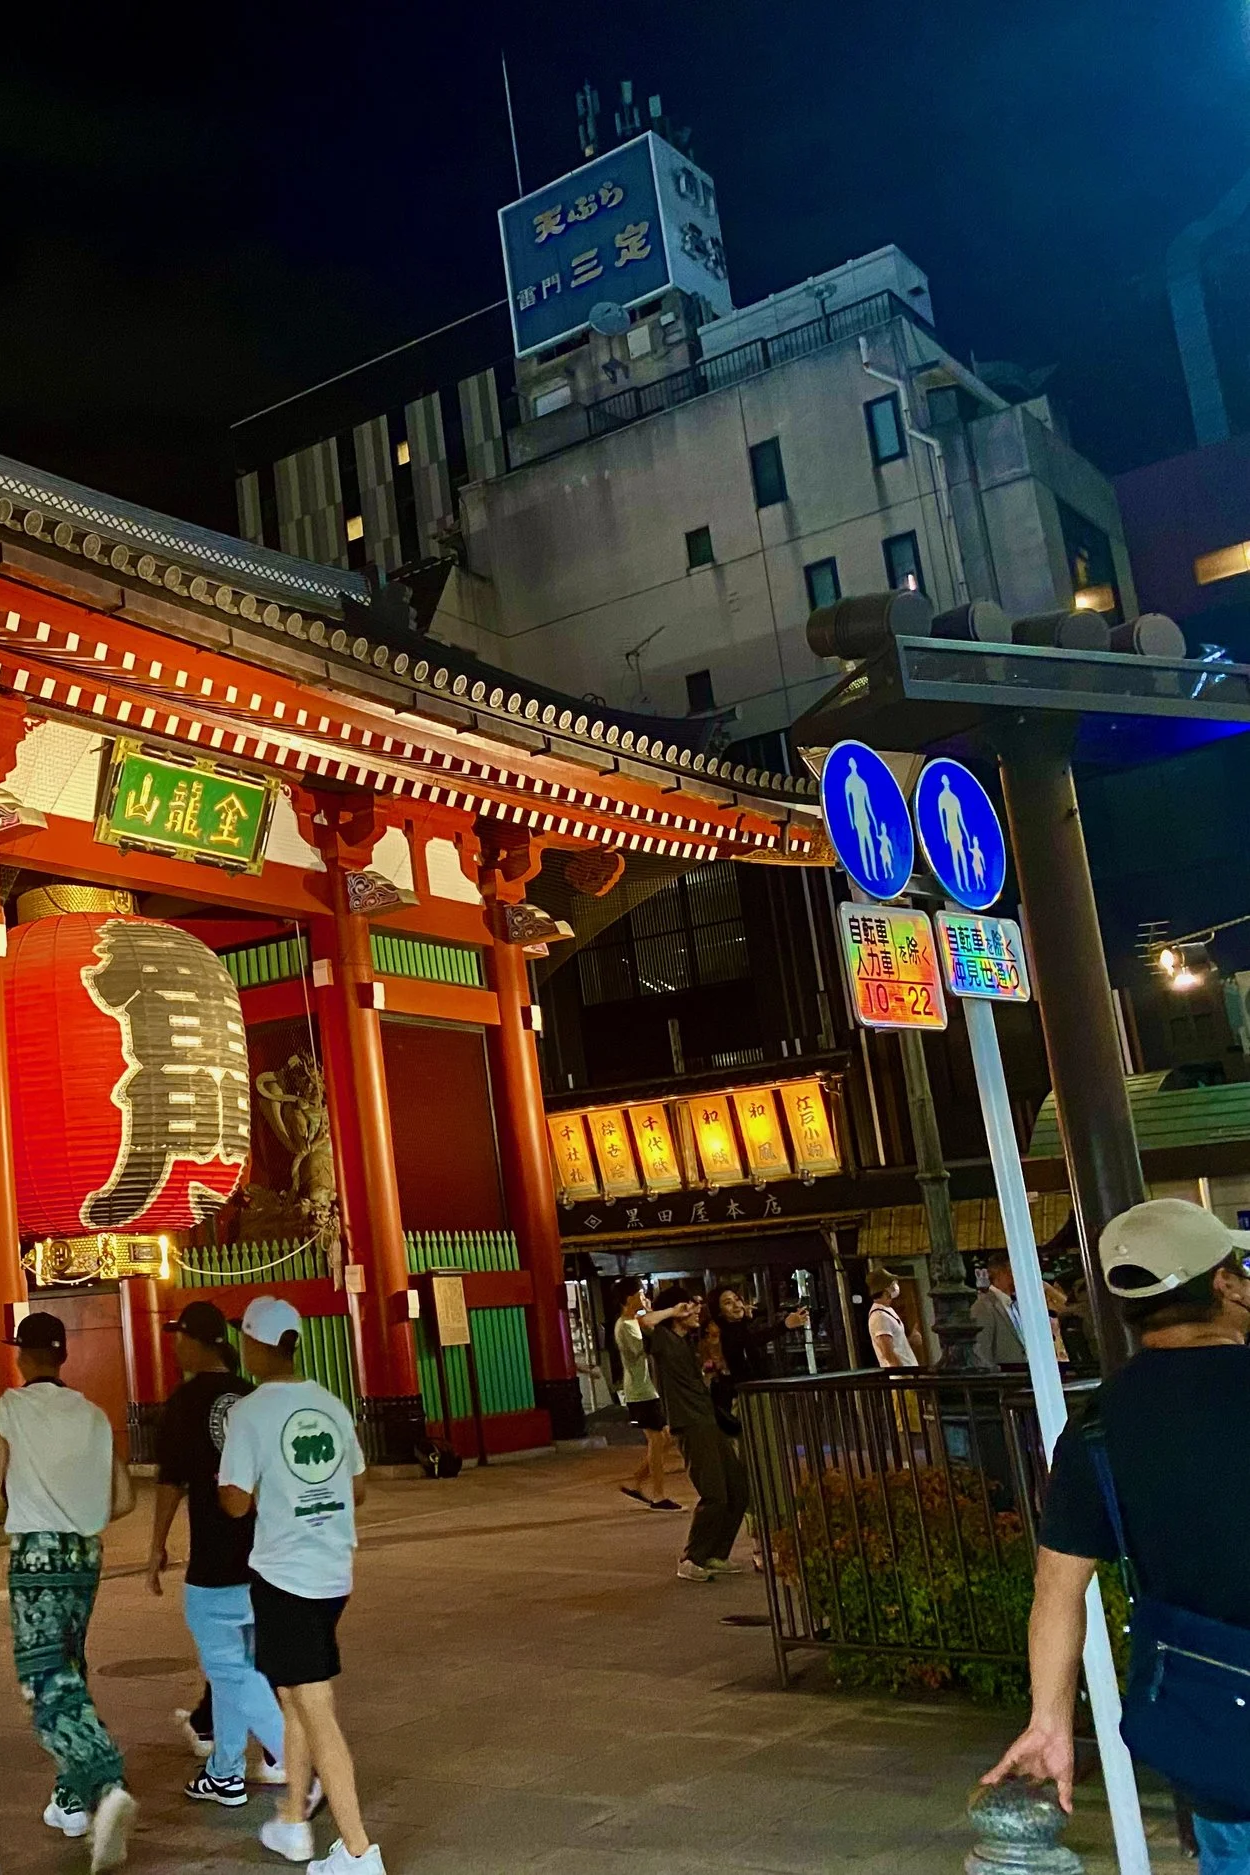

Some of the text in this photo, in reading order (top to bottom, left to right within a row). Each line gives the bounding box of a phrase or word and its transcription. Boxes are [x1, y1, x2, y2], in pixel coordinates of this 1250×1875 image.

[532, 180, 624, 244] 天ぷら
[516, 272, 561, 311] 雷門
[570, 221, 652, 288] 三定
[848, 914, 931, 966] 自転車 を除く
[945, 924, 1017, 959] 自転車を除く
[856, 946, 895, 979] 人力車
[952, 959, 1020, 990] 仲見世通り
[865, 983, 934, 1016] 10-22
[79, 916, 251, 1230] 雷門
[625, 1194, 782, 1229] 黒田屋本店
